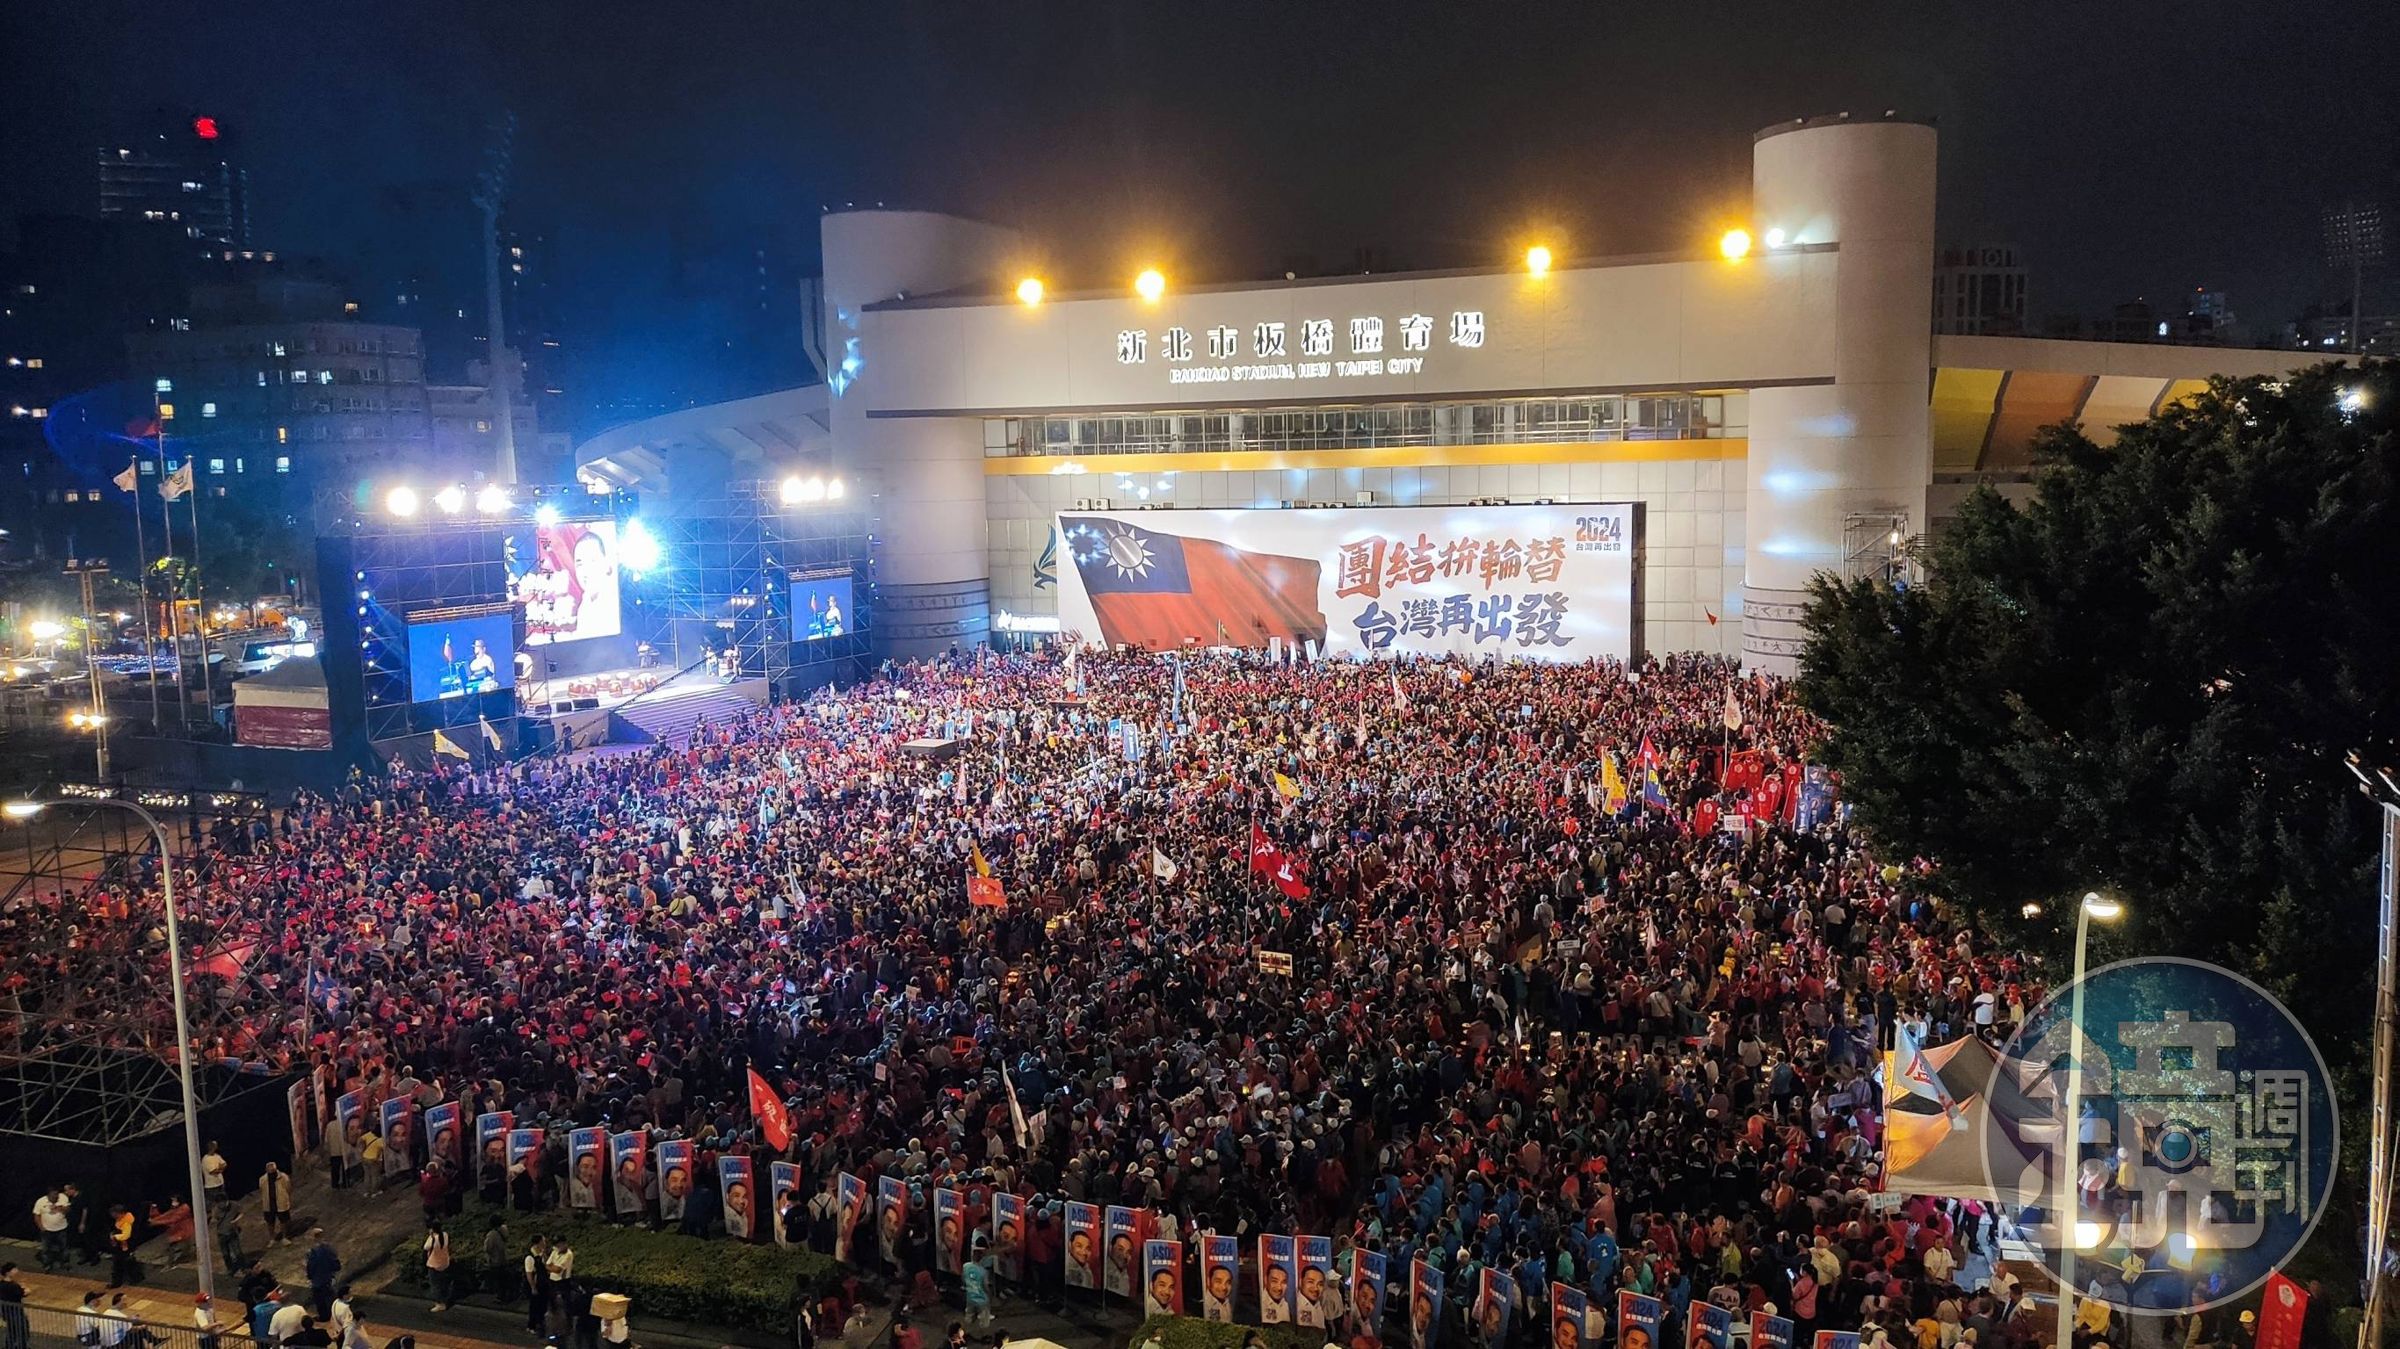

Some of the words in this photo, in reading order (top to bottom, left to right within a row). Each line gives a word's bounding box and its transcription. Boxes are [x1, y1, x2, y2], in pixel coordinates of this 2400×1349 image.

[1117, 311, 1485, 364] 新北市板橋體育場
[1298, 361, 1331, 378] NEW
[1335, 360, 1384, 377] TAIPEI
[1387, 357, 1424, 374] CITY
[1576, 516, 1622, 542] 2024
[1353, 591, 1575, 651] 台灣再出發
